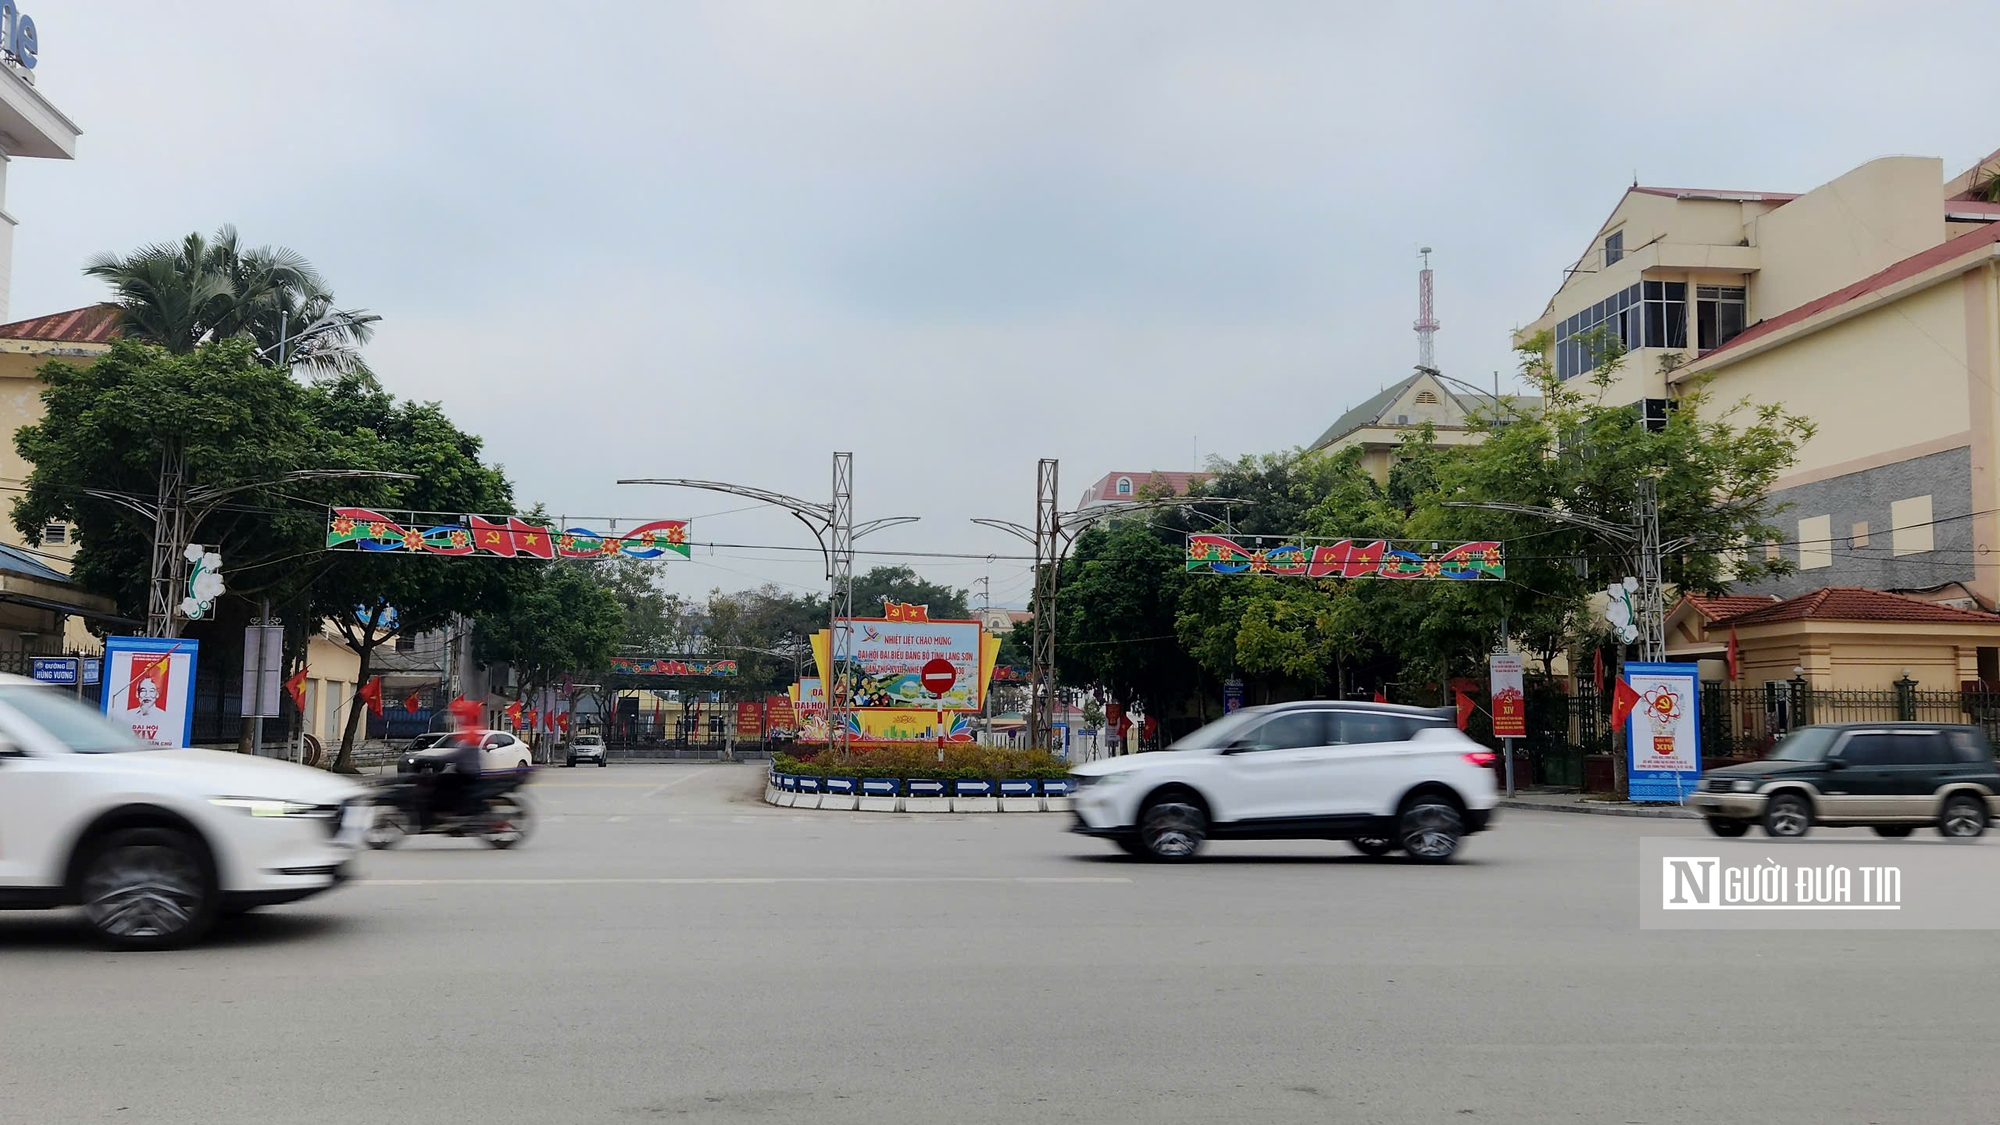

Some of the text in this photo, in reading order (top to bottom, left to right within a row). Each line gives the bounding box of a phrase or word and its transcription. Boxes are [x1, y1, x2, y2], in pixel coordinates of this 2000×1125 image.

[884, 634, 952, 646] NHIỆT LIỆT CHÀO MỪNG
[858, 650, 867, 660] ĐẠI
[869, 648, 878, 660] HỘI
[880, 650, 889, 660] ĐẠI
[905, 649, 921, 660] ĐẢNG
[962, 651, 973, 661] SƠN
[36, 669, 53, 679] HÙNG
[54, 670, 73, 679] VƯƠNG
[794, 701, 809, 710] ĐẠI
[811, 701, 826, 710] HỘI
[1503, 705, 1514, 715] XIV
